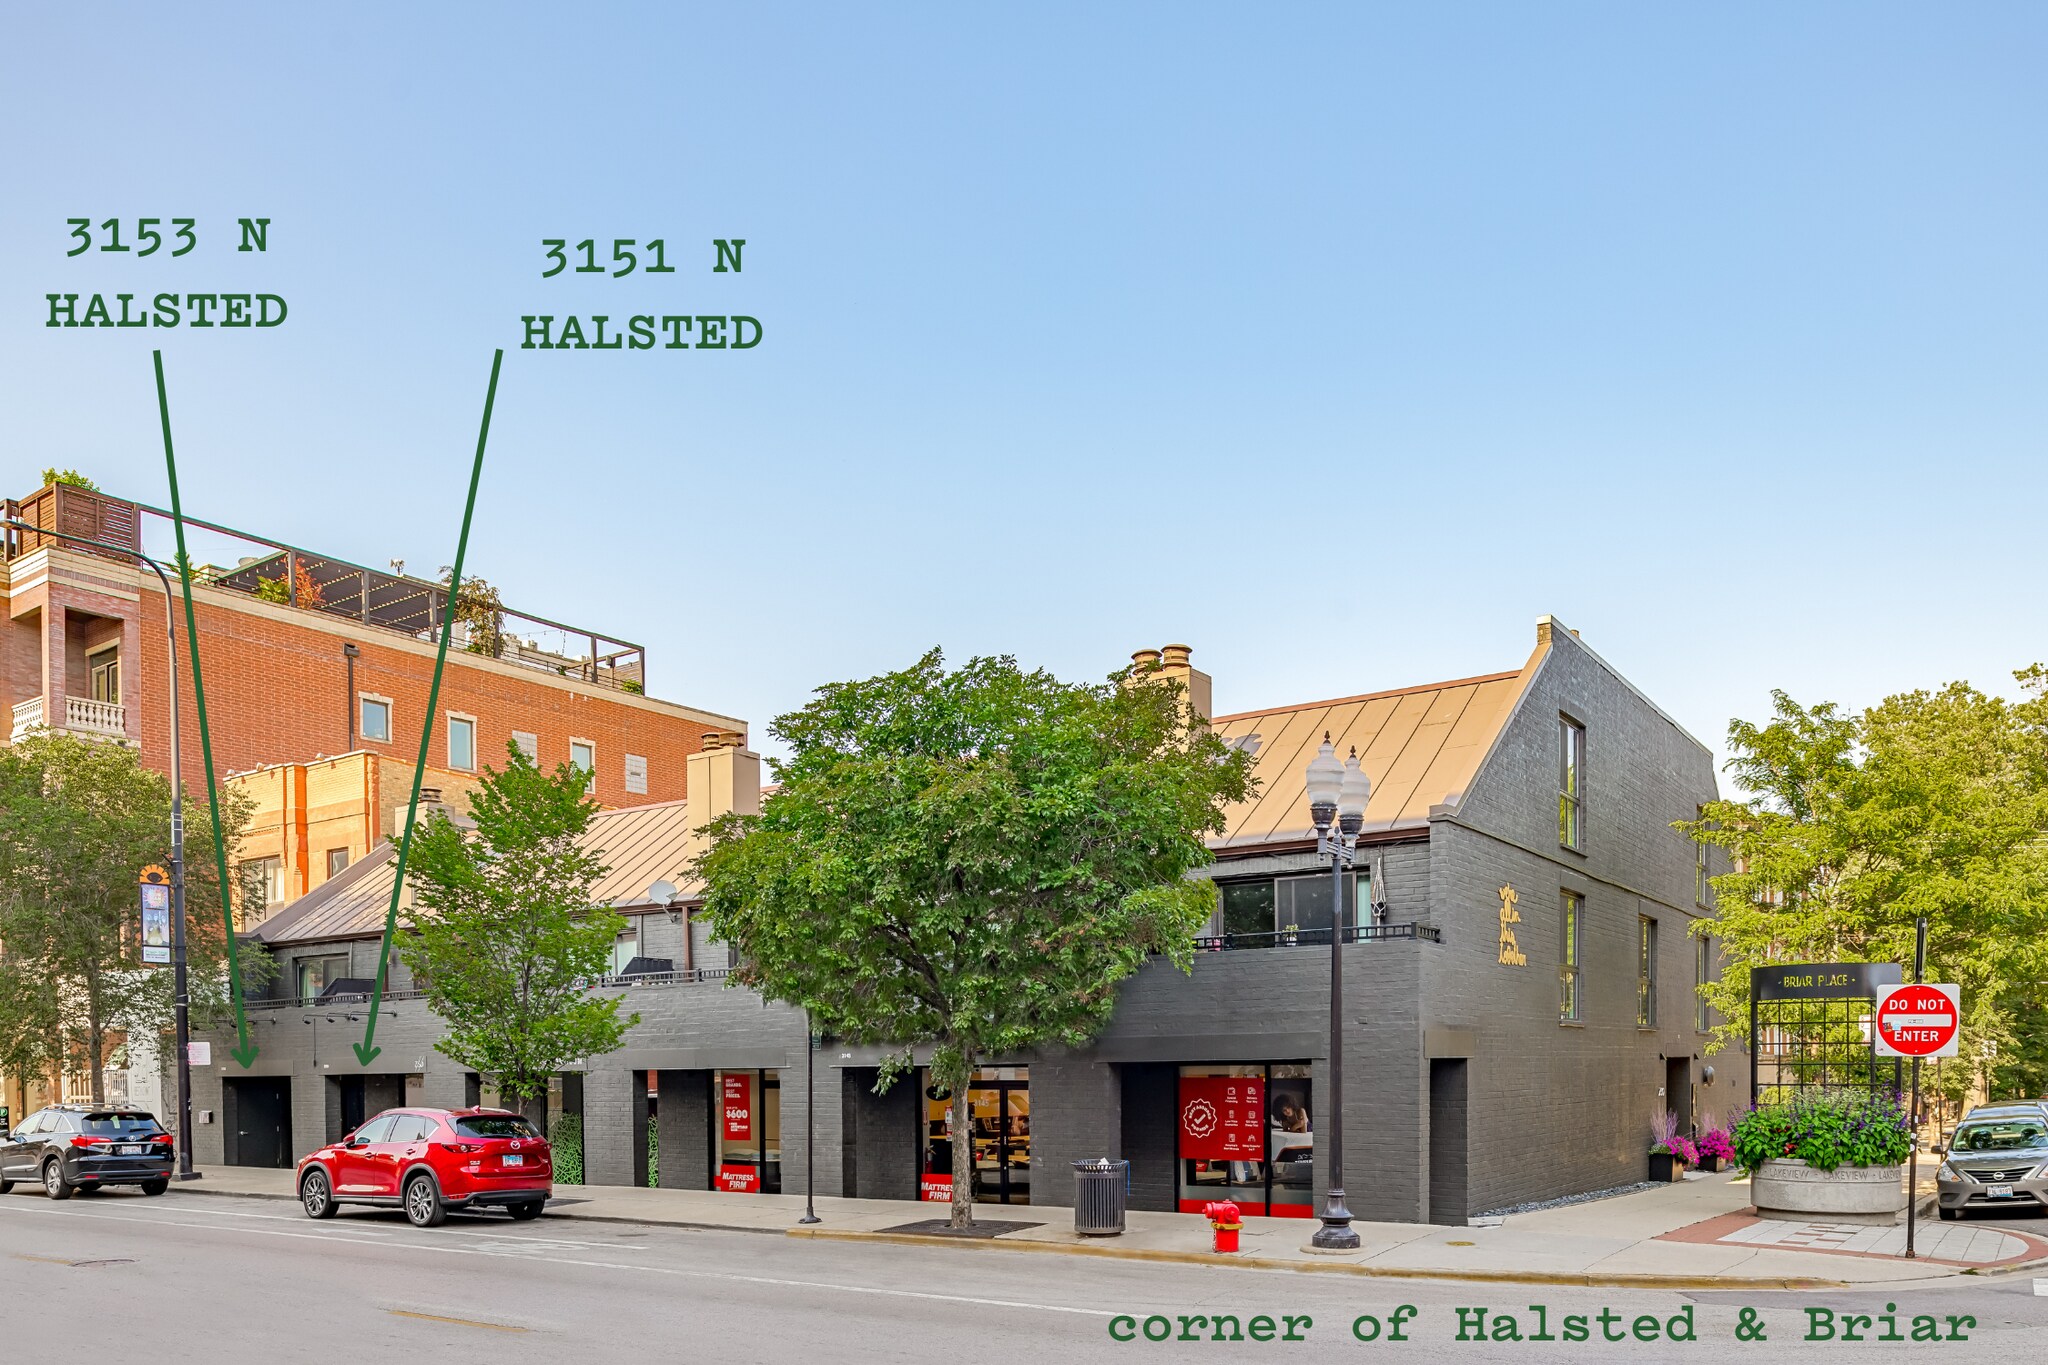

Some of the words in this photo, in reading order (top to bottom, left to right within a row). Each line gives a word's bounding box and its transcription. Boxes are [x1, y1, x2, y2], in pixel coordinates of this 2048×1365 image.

[1783, 976, 1813, 987] BRIAR
[1817, 974, 1848, 987] PLACE
[1889, 999, 1908, 1010] DO
[1917, 999, 1946, 1010] NOT
[1893, 1030, 1939, 1042] ENTER
[726, 1109, 748, 1119] $600
[1769, 1168, 1810, 1179] LAKEVIEW
[1823, 1170, 1869, 1180] LAKEVIEW
[729, 1180, 747, 1189] FIRM
[929, 1191, 951, 1200] FIRM
